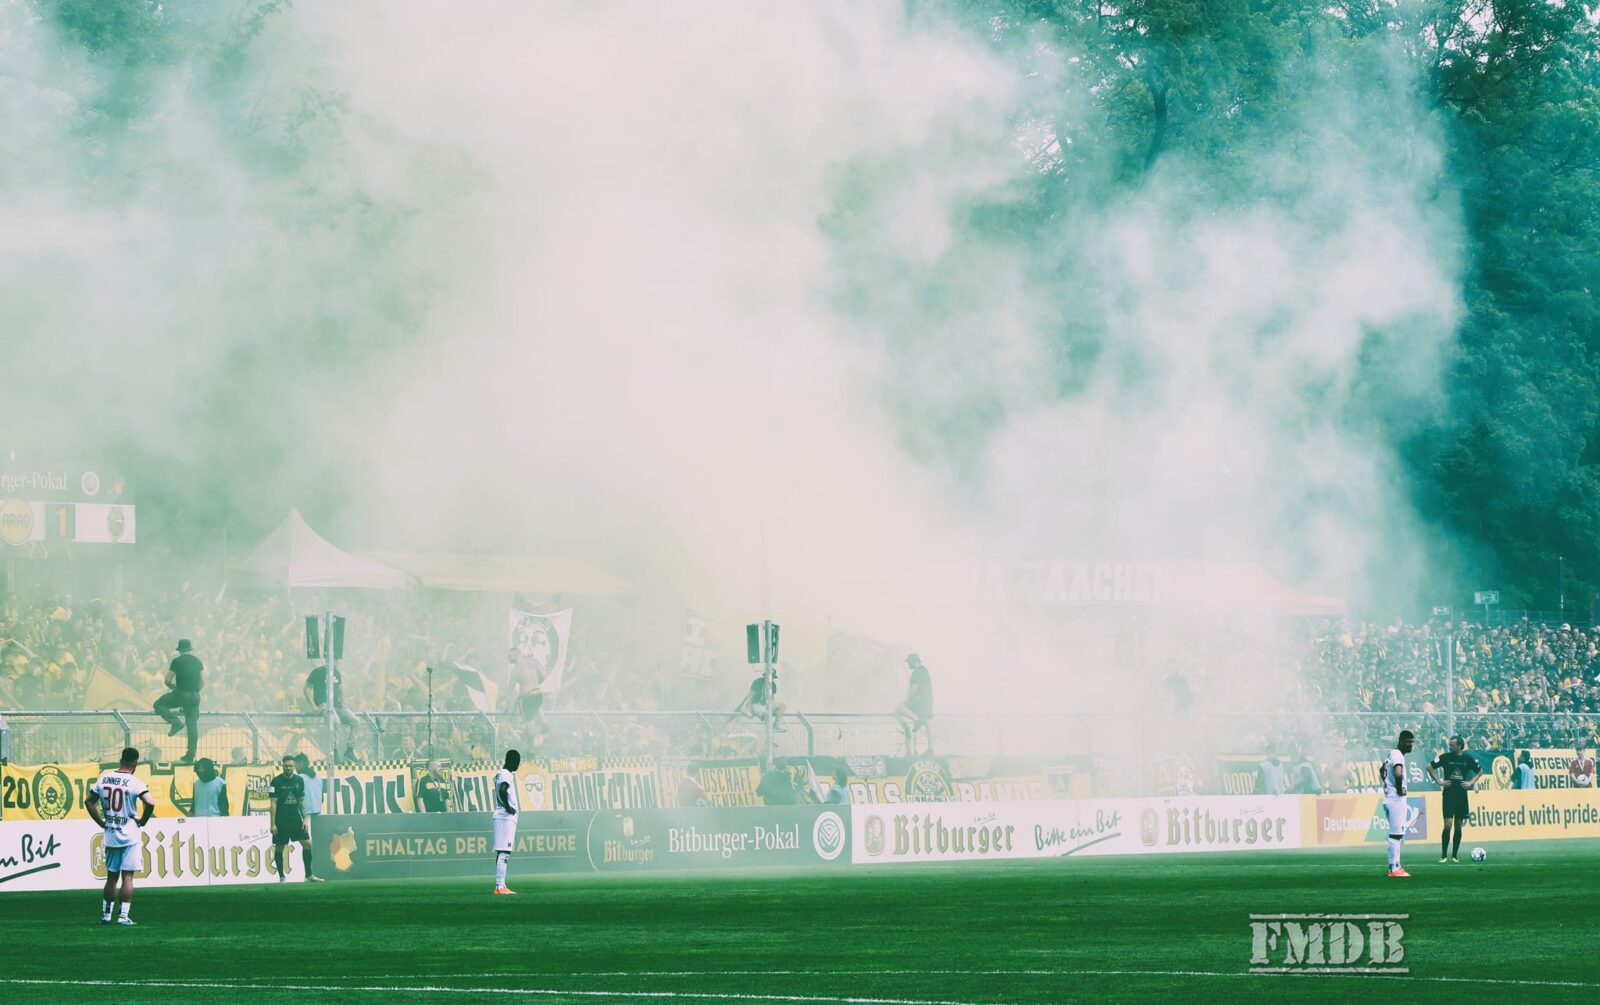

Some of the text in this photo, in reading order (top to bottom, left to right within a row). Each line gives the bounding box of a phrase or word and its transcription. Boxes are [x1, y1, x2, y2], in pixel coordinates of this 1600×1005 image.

[0, 471, 67, 493] rger-Pokal
[103, 786, 123, 812] 30
[1096, 809, 1122, 834] Bit
[1166, 807, 1286, 845] Bitburger
[1372, 814, 1390, 830] Pos
[1464, 803, 1600, 829] elivered with pride.
[366, 834, 577, 857] FINALTAG DER ATEURE
[668, 823, 800, 859] Bitburger-Pokal
[893, 814, 1015, 855] Bitburger
[21, 833, 61, 864] Bit
